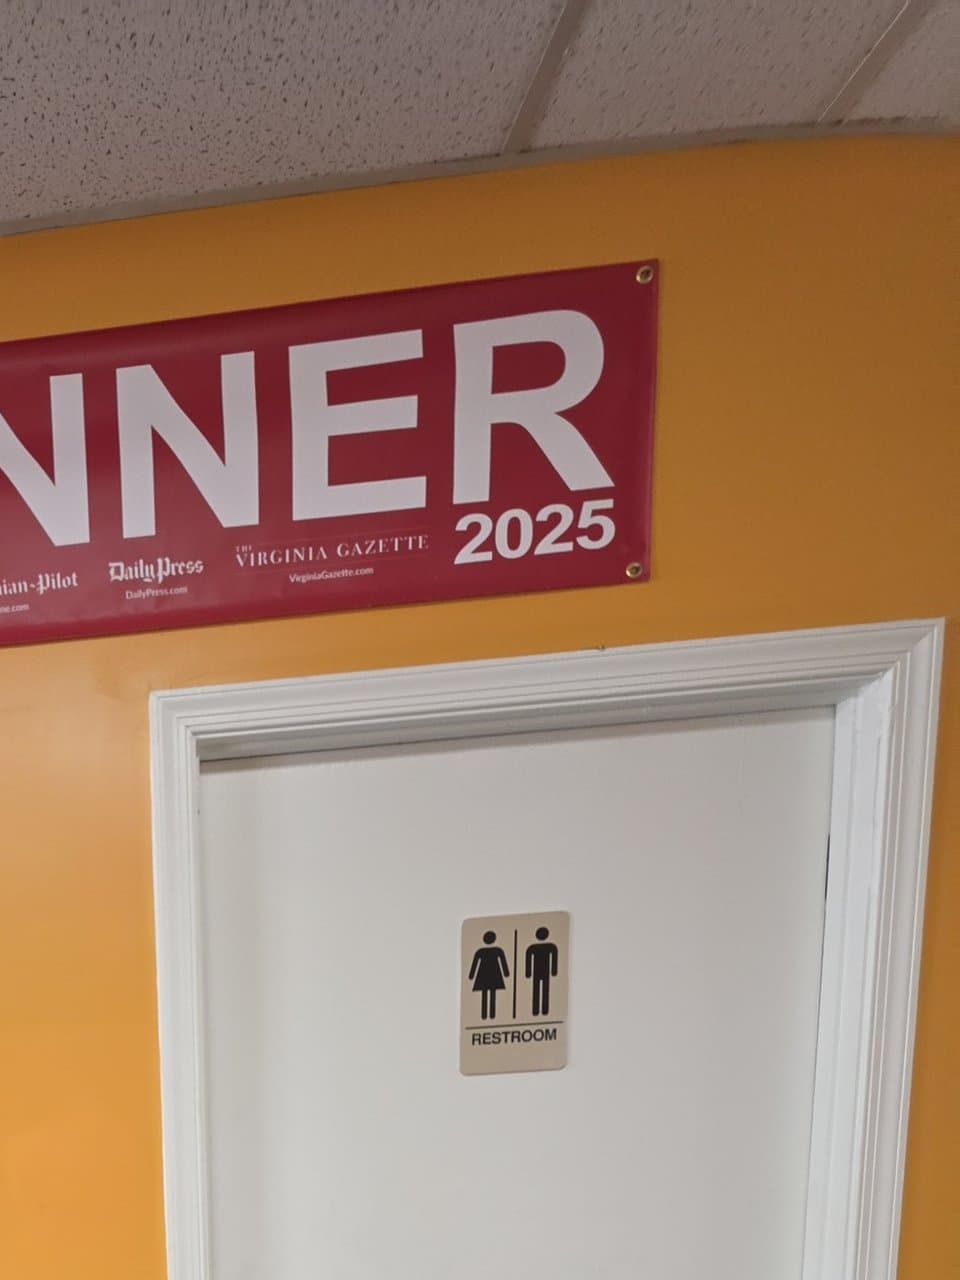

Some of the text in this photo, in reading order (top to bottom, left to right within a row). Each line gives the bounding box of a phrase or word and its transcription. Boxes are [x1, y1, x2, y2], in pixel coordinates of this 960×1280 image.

[453, 498, 616, 566] 2025
[235, 535, 429, 568] VIRGINIA GAZETTE
[108, 556, 204, 584] Daily Press
[289, 565, 374, 584] VirginiaGazette.com
[125, 585, 188, 600] DailyPress.com
[471, 1028, 557, 1046] RESTROOM
